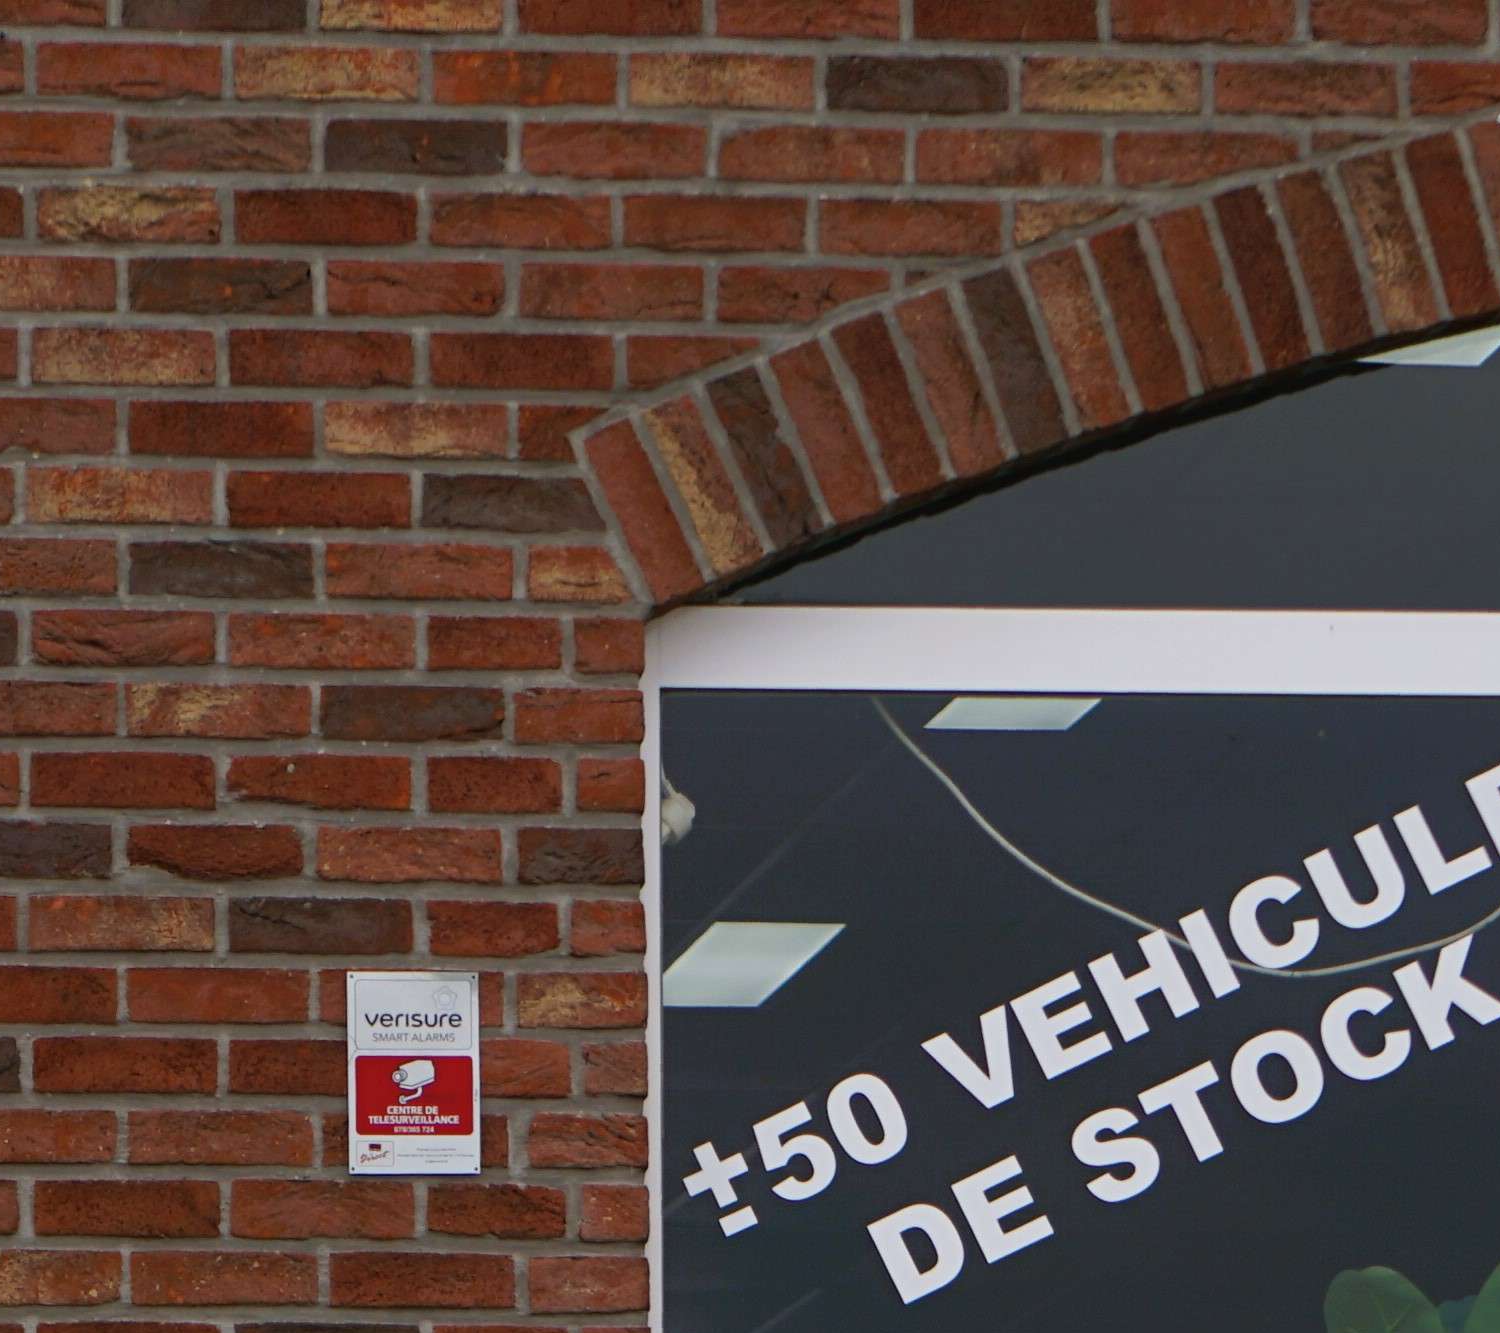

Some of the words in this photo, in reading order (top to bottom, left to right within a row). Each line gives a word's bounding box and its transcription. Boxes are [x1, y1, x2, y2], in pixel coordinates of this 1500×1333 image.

[364, 1013, 463, 1028] verisure
[372, 1033, 409, 1042] SMART
[411, 1033, 456, 1042] ALARMS
[387, 1106, 423, 1115] CENTRE
[425, 1106, 438, 1115] DE
[866, 1154, 1054, 1305] DE
